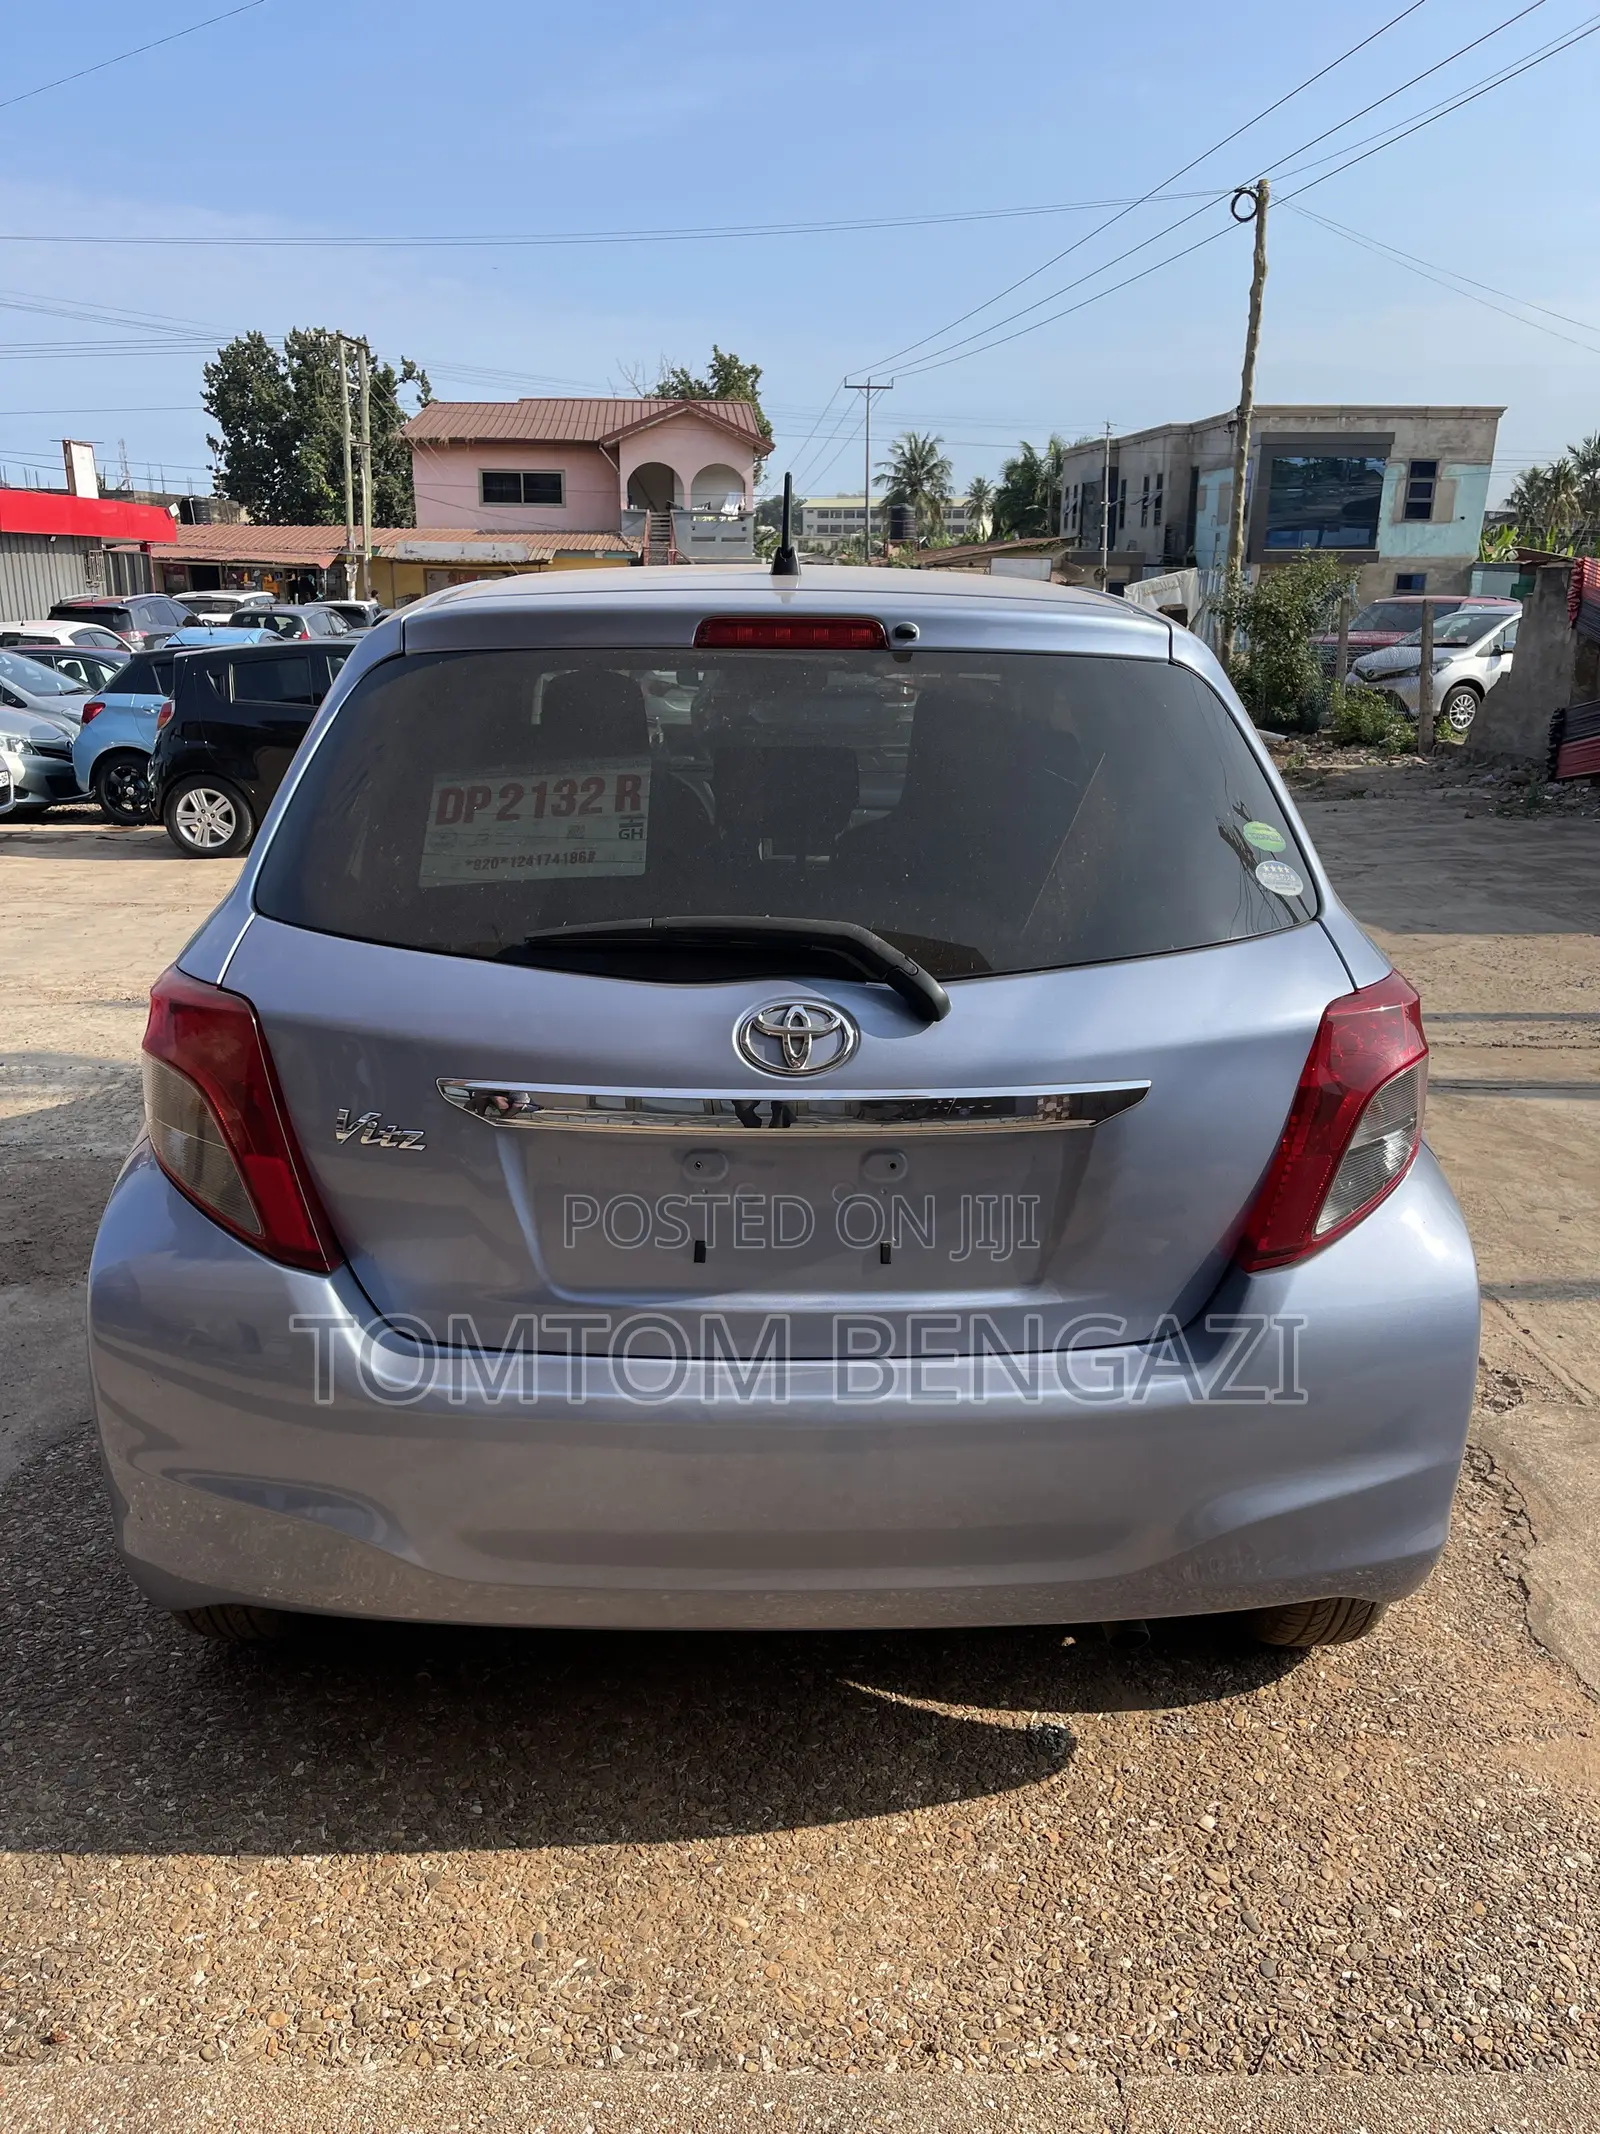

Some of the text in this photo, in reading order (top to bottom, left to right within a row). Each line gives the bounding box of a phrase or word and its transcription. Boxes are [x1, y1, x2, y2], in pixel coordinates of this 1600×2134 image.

[435, 773, 643, 826] DP 2132 R
[618, 827, 644, 840] GH
[335, 1108, 427, 1151] Vitz
